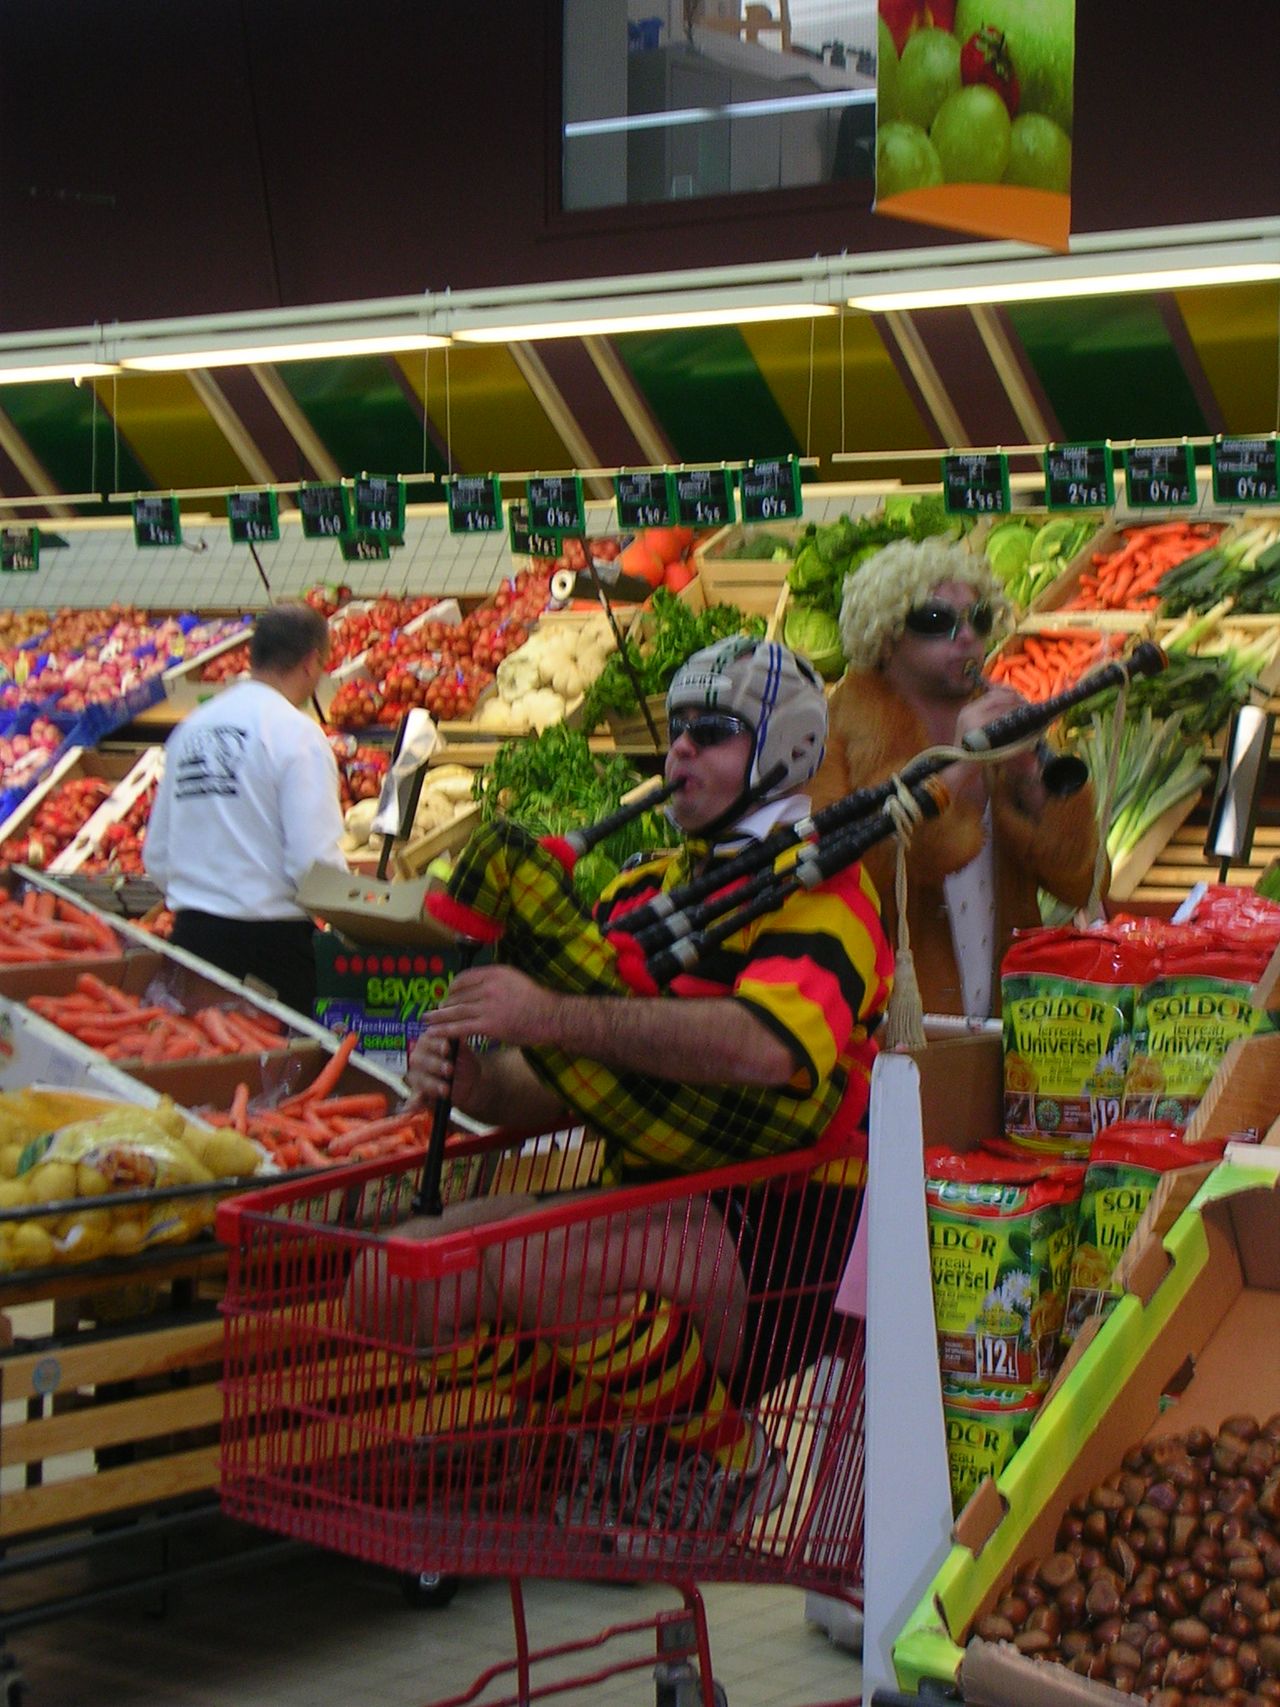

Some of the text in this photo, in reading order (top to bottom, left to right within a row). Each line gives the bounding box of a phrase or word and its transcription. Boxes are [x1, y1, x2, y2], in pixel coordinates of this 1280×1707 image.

[1018, 998, 1105, 1024] SOLDOR
[1153, 996, 1253, 1025] SOLDOR
[1020, 1029, 1100, 1054] Universel
